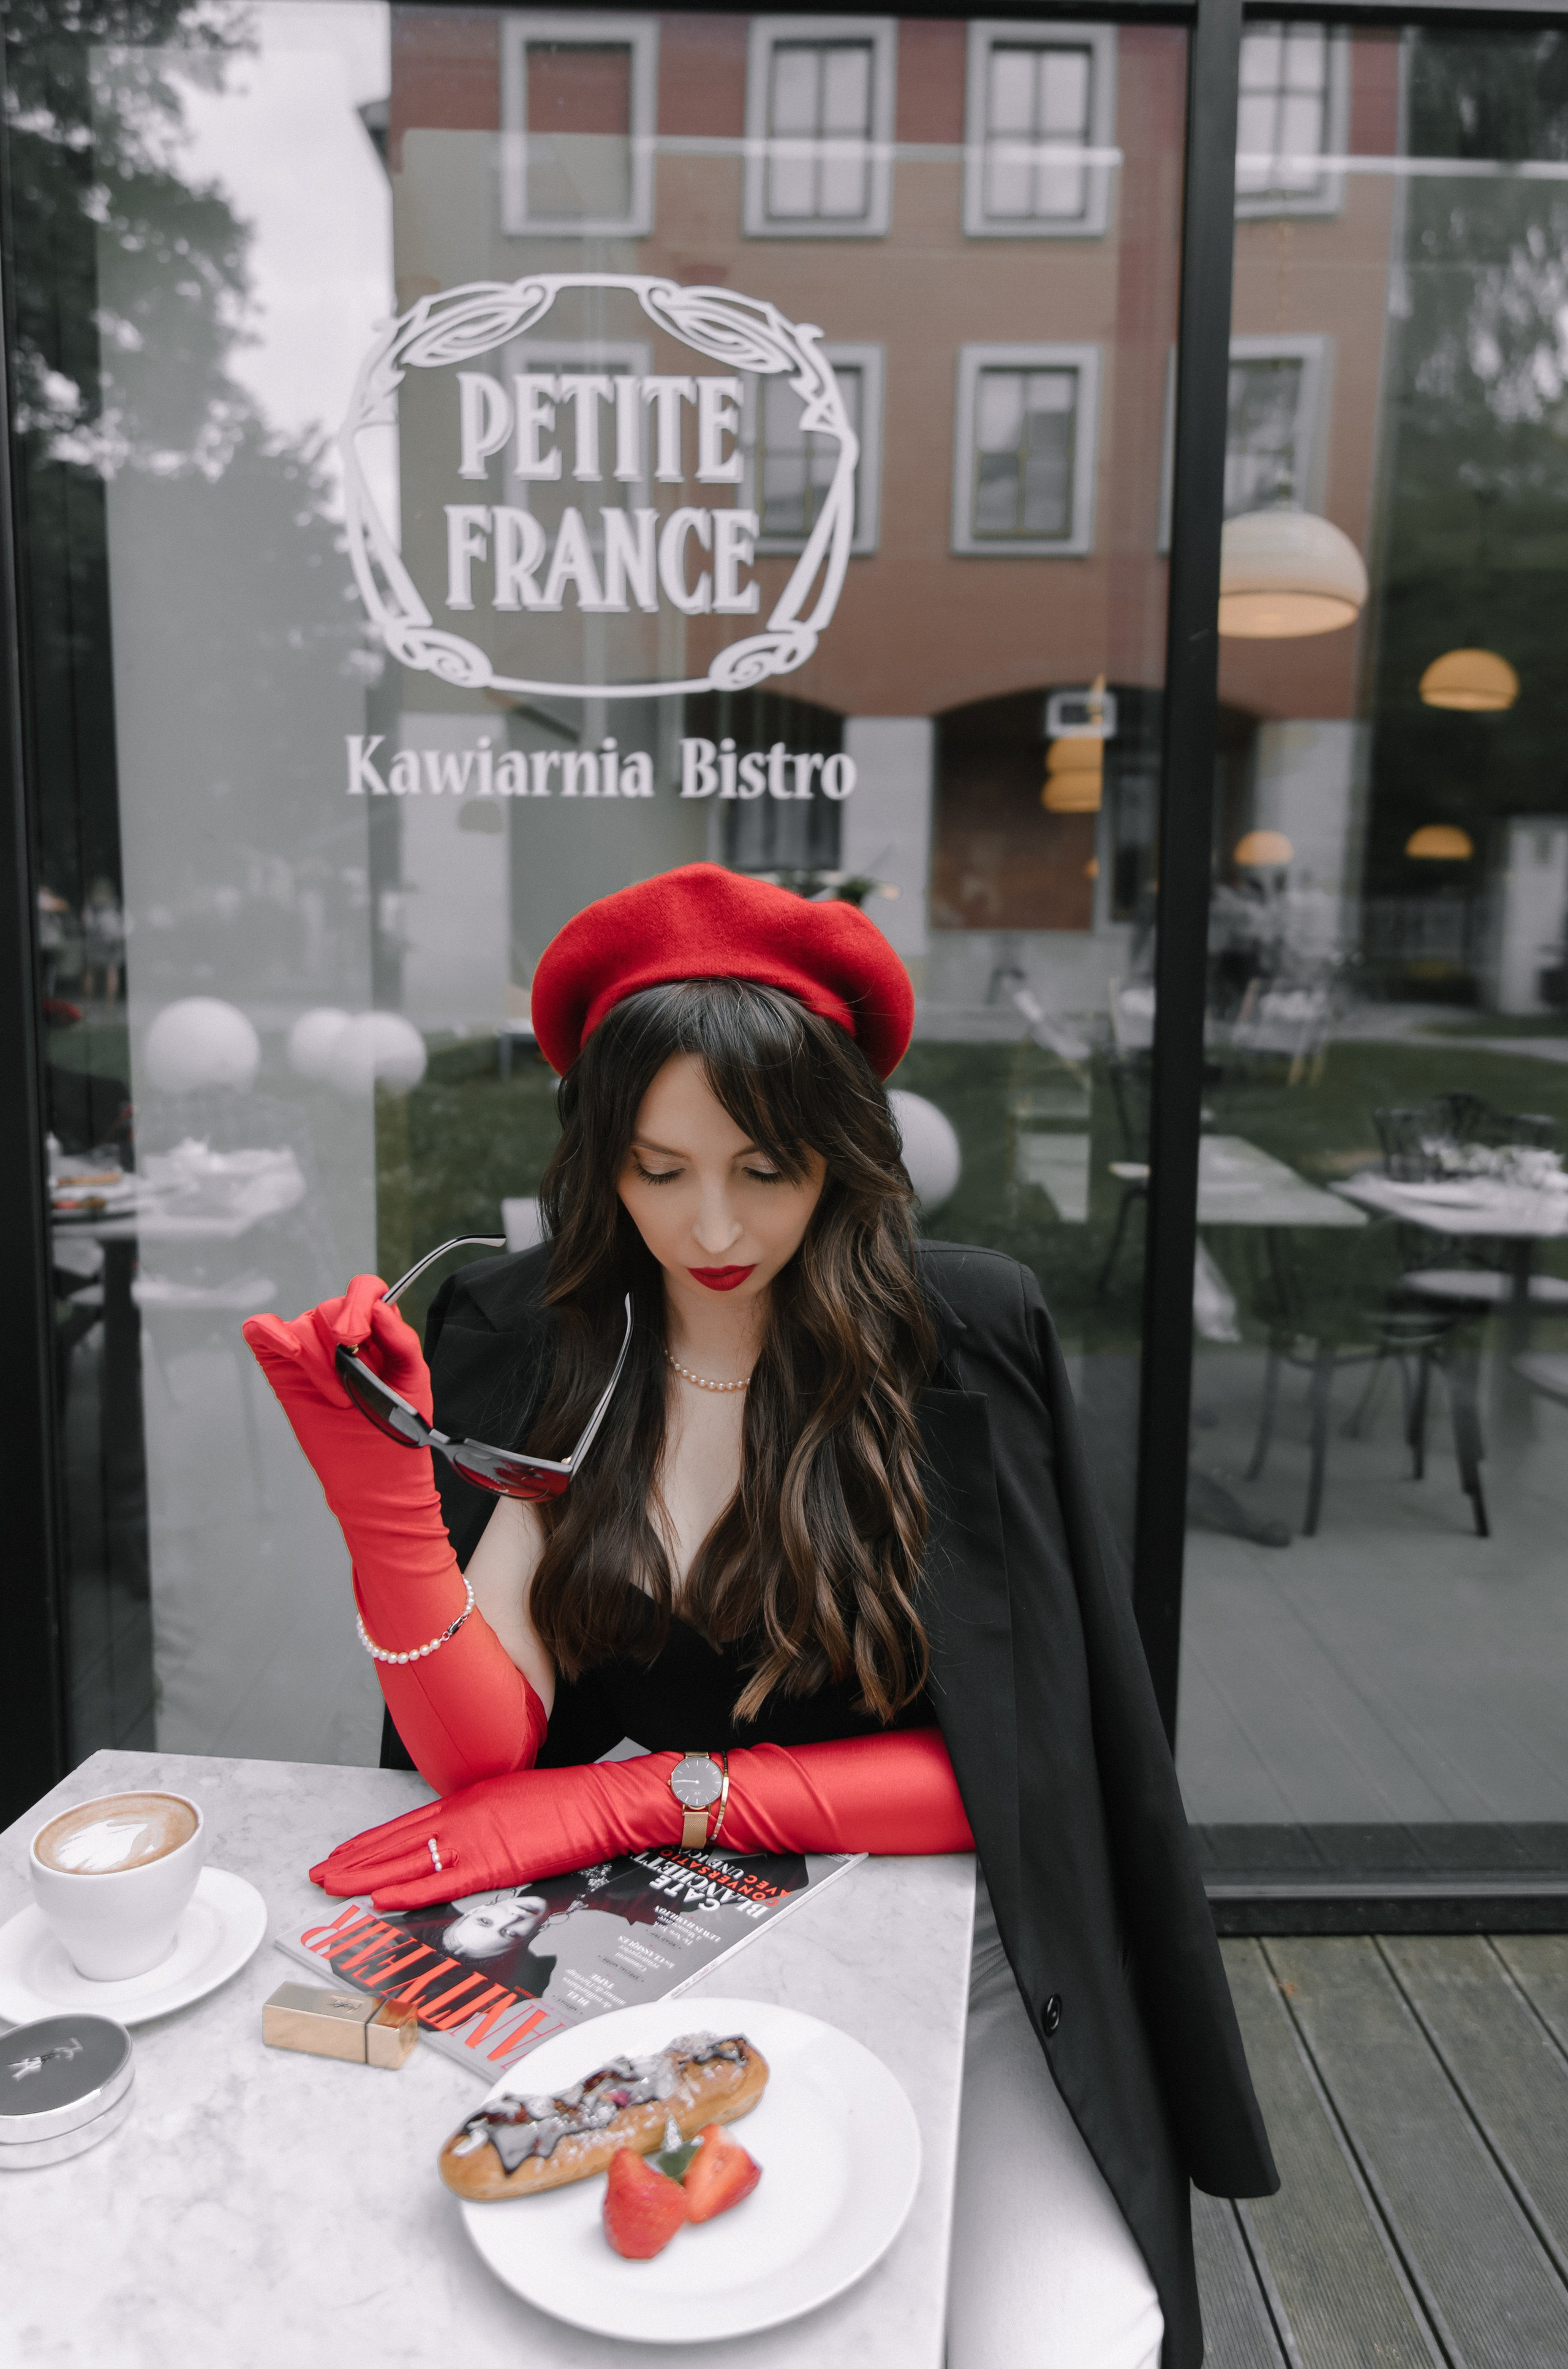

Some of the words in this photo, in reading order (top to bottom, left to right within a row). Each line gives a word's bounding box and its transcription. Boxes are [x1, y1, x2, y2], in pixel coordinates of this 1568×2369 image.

[456, 371, 744, 483] PETITE
[443, 504, 760, 614] FRANCE
[344, 734, 655, 797] Kawiarnia
[679, 737, 858, 800] Bistro
[662, 1849, 778, 1907] CONVERSATIO
[706, 1858, 744, 1880] UNE
[628, 1850, 771, 1919] BLANCHETT
[647, 1873, 717, 1913] CATE
[742, 1873, 793, 1897] AVEC
[652, 1904, 695, 1929] HAMILTON
[652, 1920, 668, 1932] York
[660, 1936, 677, 1946] ROAD
[667, 1929, 683, 1940] New
[692, 1924, 721, 1942] LEWIS
[303, 1904, 437, 1988] FAIR
[617, 1934, 665, 1963] CLASSIQUES
[601, 1956, 619, 1967] MODE
[614, 1951, 647, 1972] Comment
[559, 1975, 603, 2003] milliardaires
[589, 1971, 617, 1989] TAPIE
[563, 1989, 591, 2006] DUEL
[598, 1999, 612, 2009] de
[379, 1956, 565, 2070] ANITY
